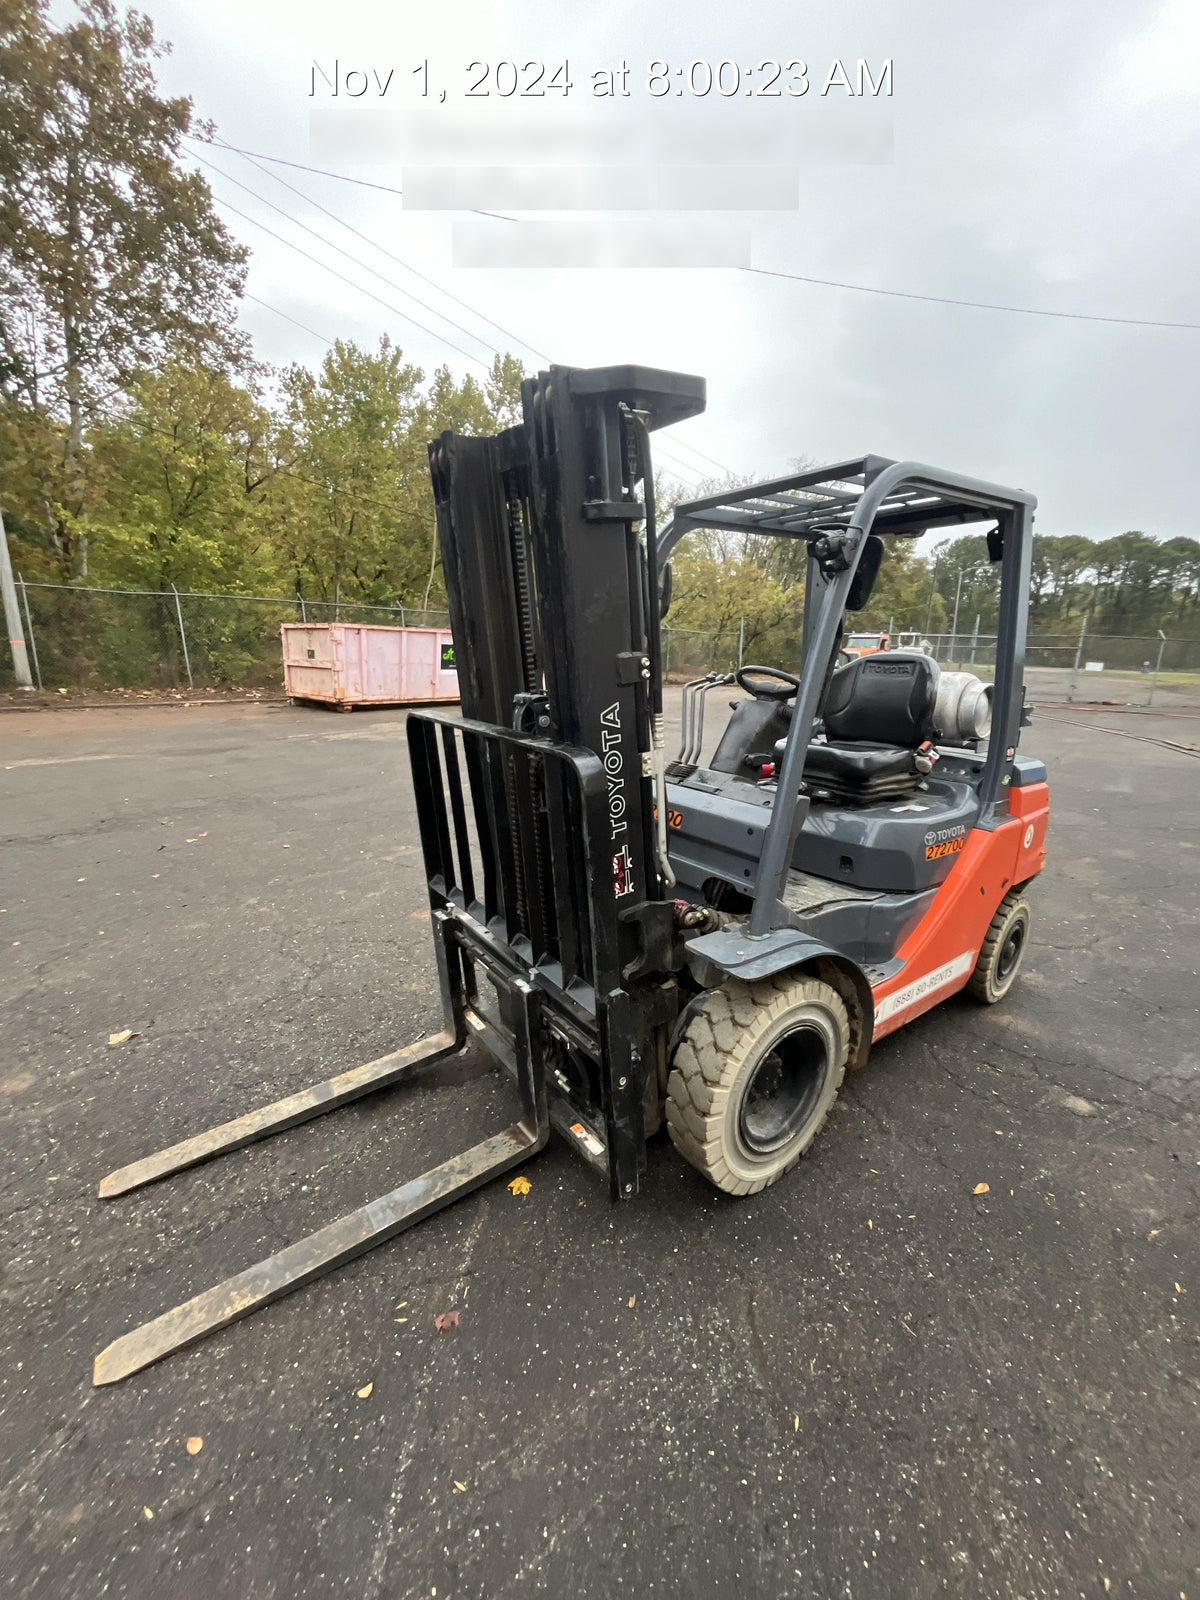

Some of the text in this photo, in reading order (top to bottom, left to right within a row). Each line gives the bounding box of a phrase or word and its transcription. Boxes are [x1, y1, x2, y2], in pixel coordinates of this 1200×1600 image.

[868, 664, 911, 675] TOYOTA
[600, 701, 628, 840] TOYOTA
[937, 824, 966, 841] TOYOTA
[926, 837, 965, 860] 272700
